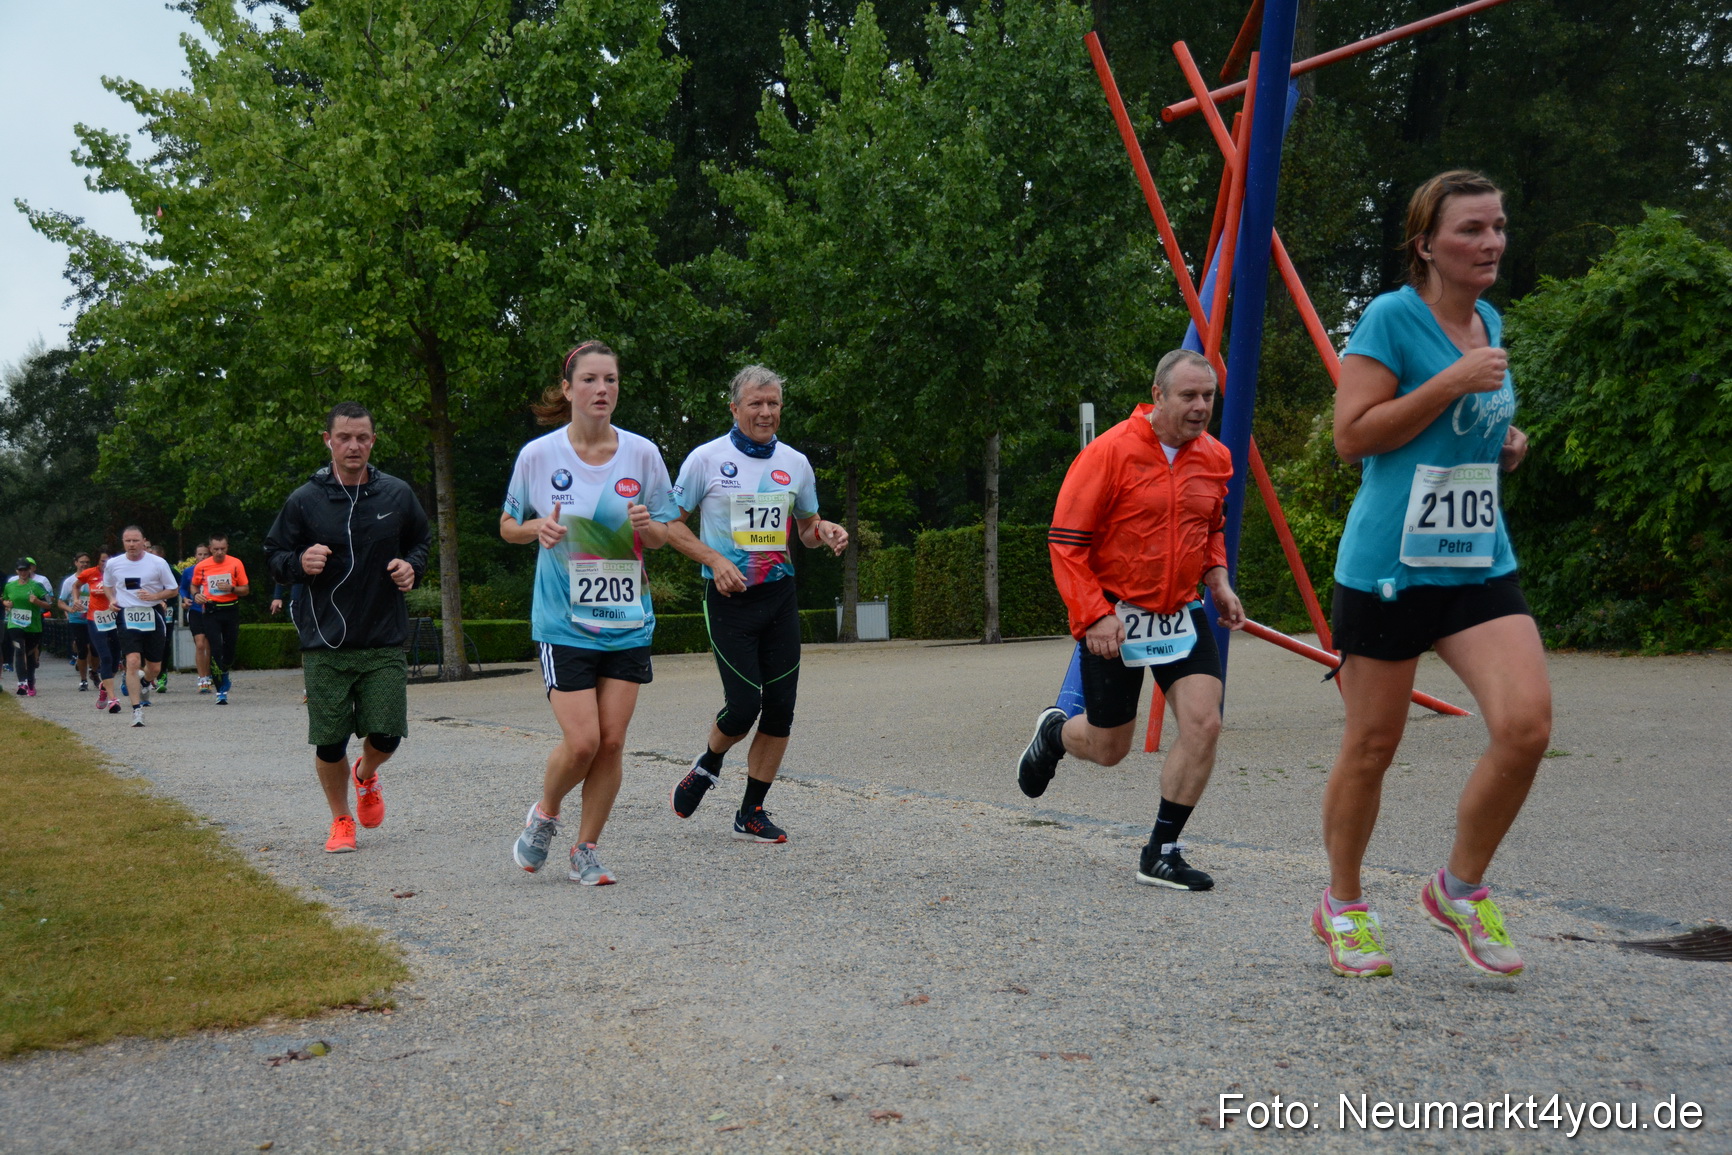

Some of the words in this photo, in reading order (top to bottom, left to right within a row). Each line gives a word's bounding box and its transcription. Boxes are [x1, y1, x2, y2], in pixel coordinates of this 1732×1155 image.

[1453, 468, 1492, 480] BOCK
[618, 482, 639, 494] Hervis
[1417, 489, 1495, 528] 2103
[744, 506, 781, 529] 173
[750, 533, 776, 543] Martin
[1438, 538, 1473, 553] Petra
[602, 562, 634, 571] BOCK
[578, 577, 635, 603] 2203
[96, 611, 117, 624] 3110
[127, 611, 151, 622] 3021
[592, 608, 627, 619] Carolin
[1125, 609, 1187, 640] 2782
[1146, 643, 1174, 656] Erwin
